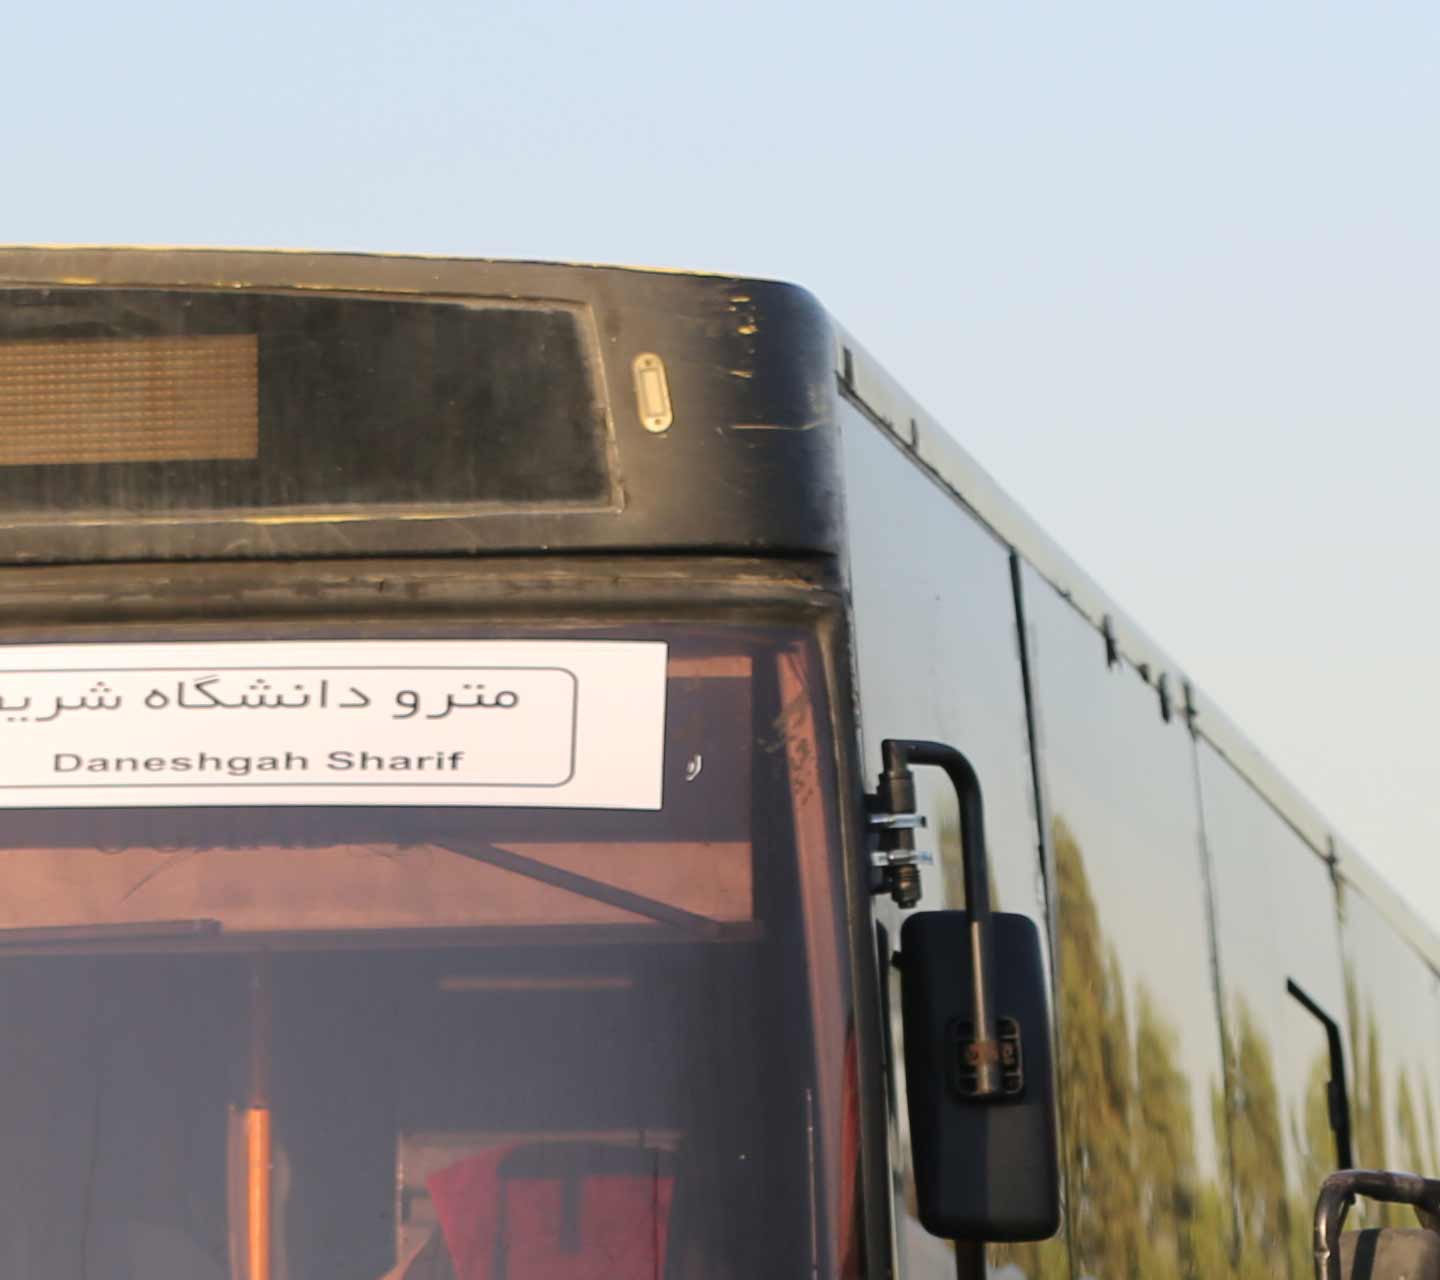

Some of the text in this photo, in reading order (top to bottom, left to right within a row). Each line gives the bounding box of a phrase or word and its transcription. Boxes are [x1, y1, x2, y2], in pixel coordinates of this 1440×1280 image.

[144, 674, 372, 709] دانشگاه
[394, 682, 520, 720] مترو
[53, 750, 466, 776] Daneshgah Sharif
